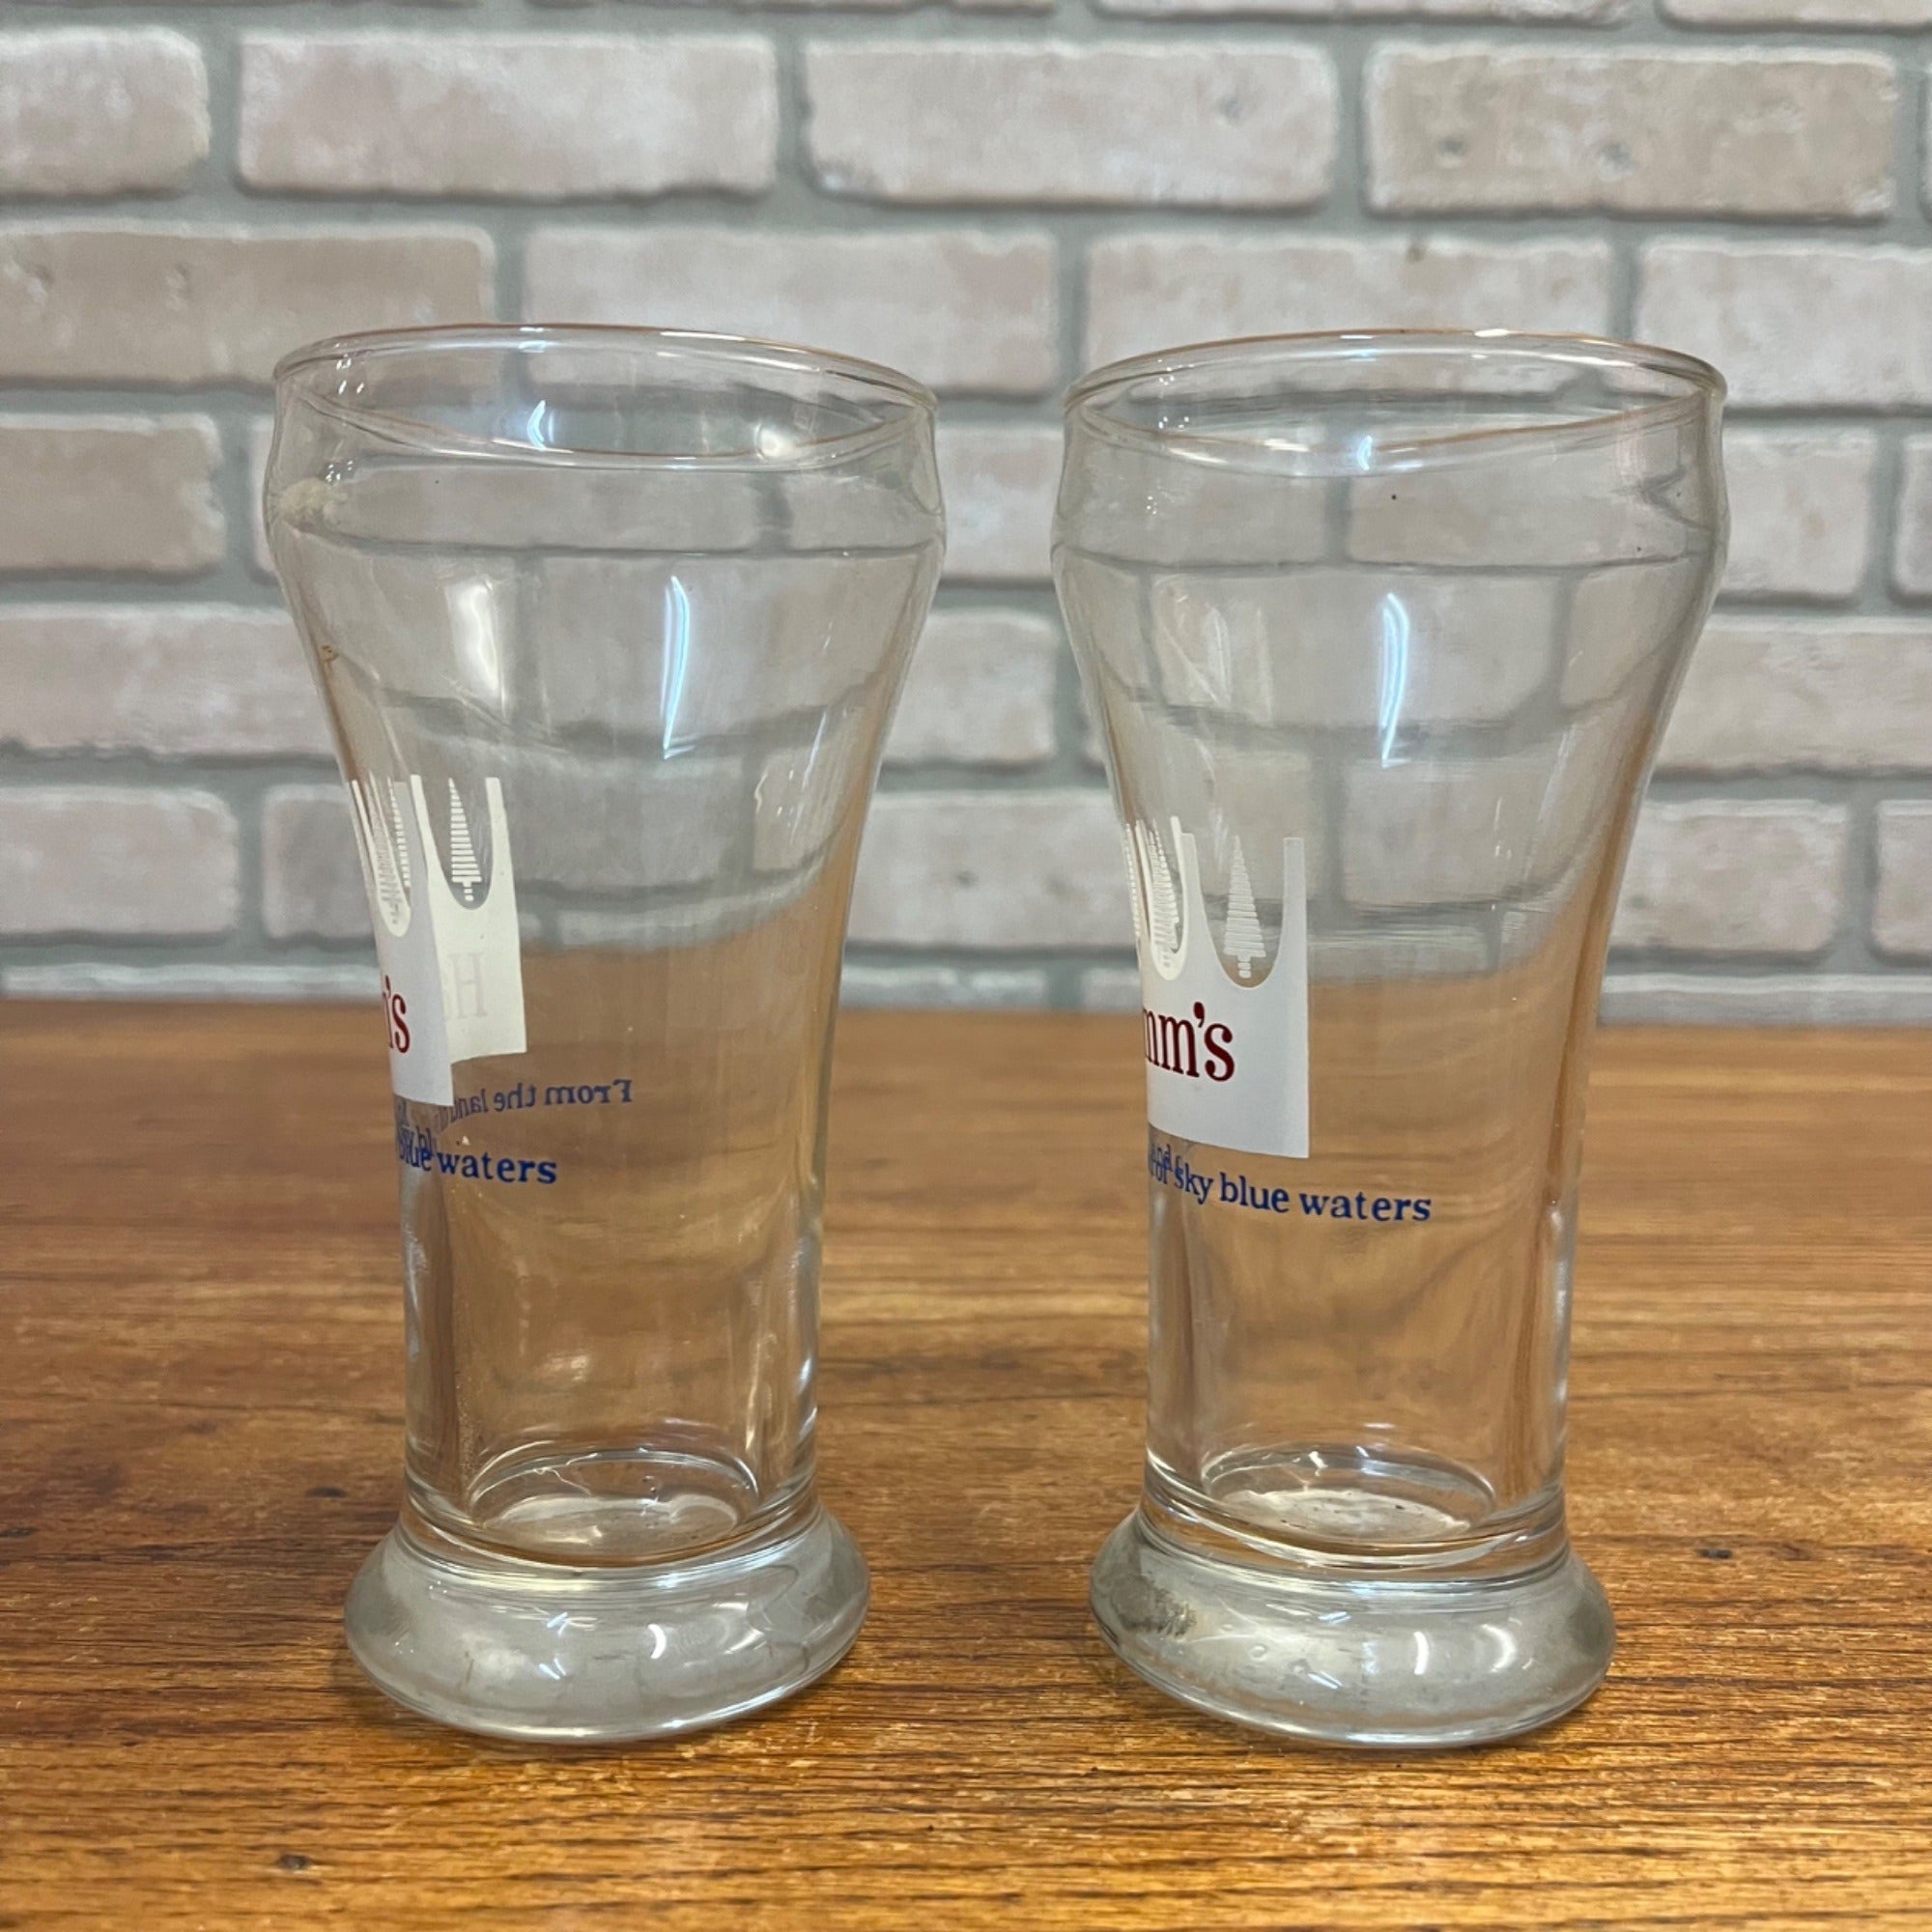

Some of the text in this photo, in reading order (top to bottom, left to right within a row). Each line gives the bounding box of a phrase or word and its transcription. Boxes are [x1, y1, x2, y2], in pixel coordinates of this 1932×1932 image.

[436, 1151, 557, 1185] waters
[1175, 1162, 1214, 1205] sky
[1219, 1171, 1290, 1213] blue
[1298, 1191, 1432, 1222] waters
